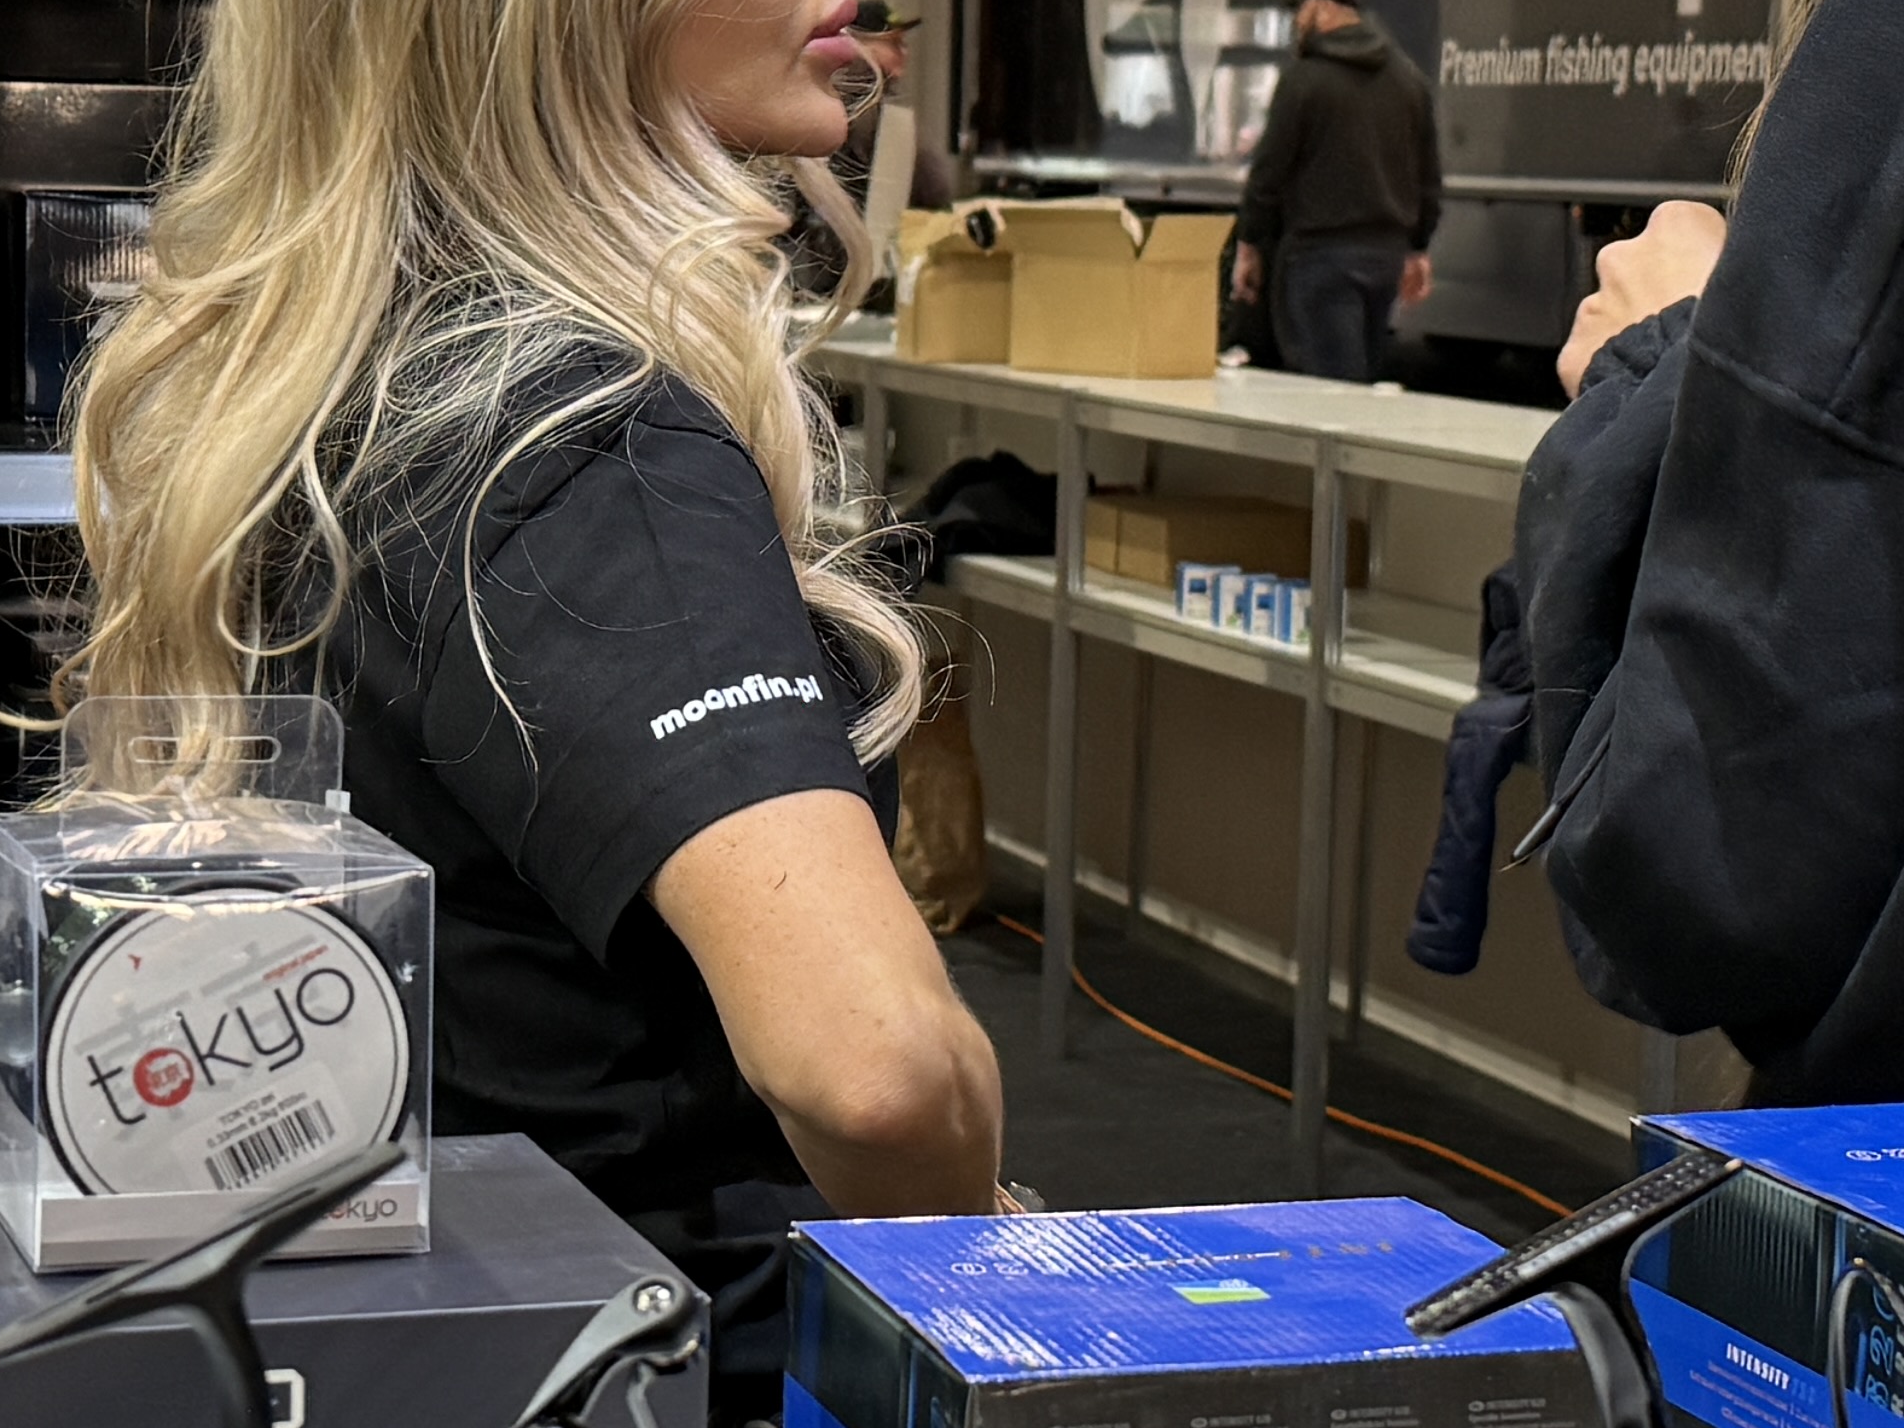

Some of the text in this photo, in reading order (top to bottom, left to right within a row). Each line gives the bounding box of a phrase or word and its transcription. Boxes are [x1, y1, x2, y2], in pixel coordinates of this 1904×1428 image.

[1439, 33, 1769, 99] Premium fishing equipmen
[650, 673, 824, 741] moonfin.pl
[89, 968, 355, 1125] tokyo
[320, 1197, 398, 1223] kyo
[1726, 1342, 1791, 1391] INTENSITY
